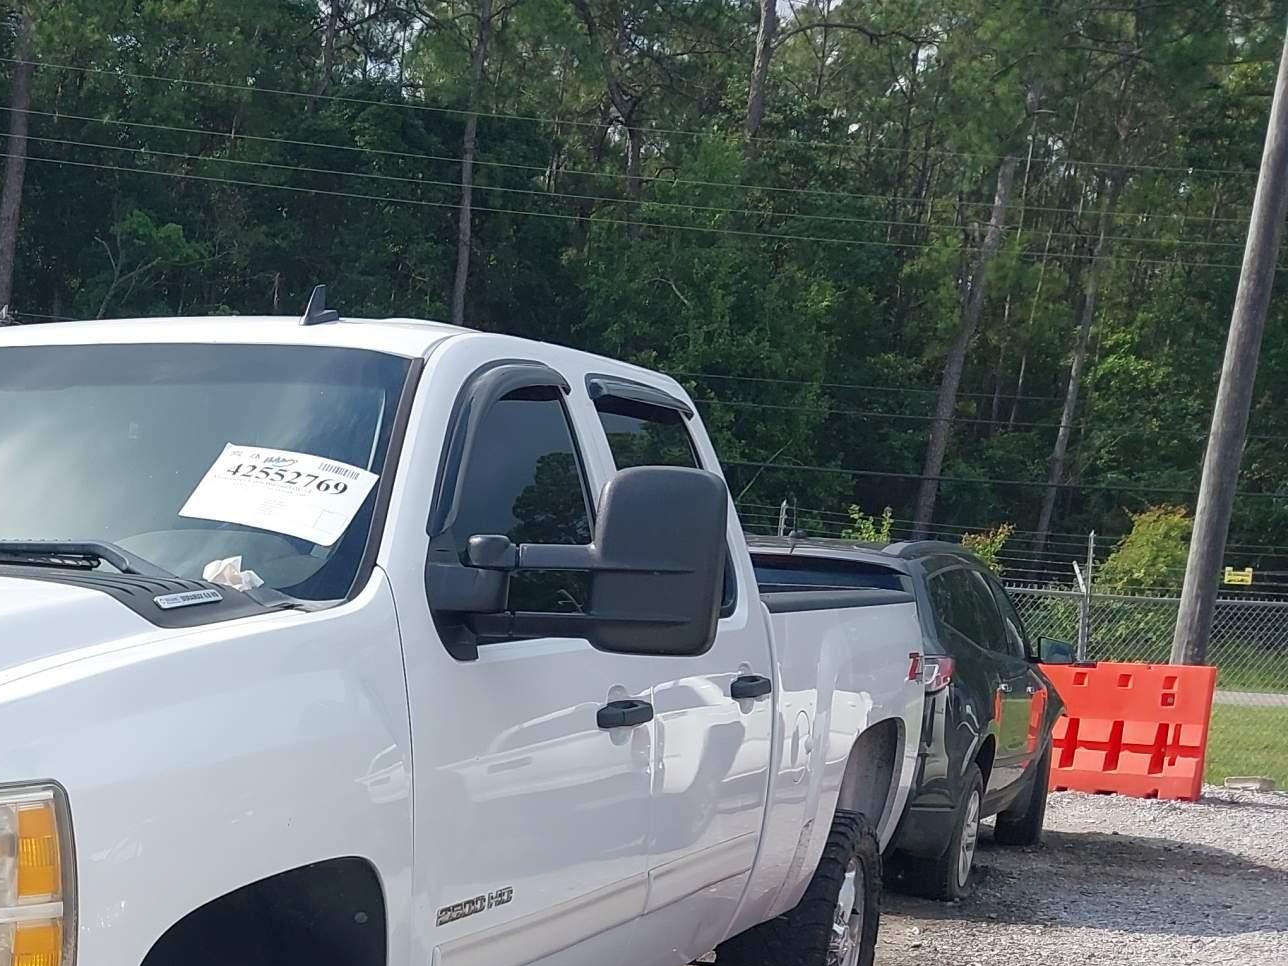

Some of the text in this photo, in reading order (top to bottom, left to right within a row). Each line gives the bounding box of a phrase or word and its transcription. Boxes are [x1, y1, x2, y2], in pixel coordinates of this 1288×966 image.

[227, 464, 348, 495] 42552769
[436, 886, 513, 927] 2500 HD
